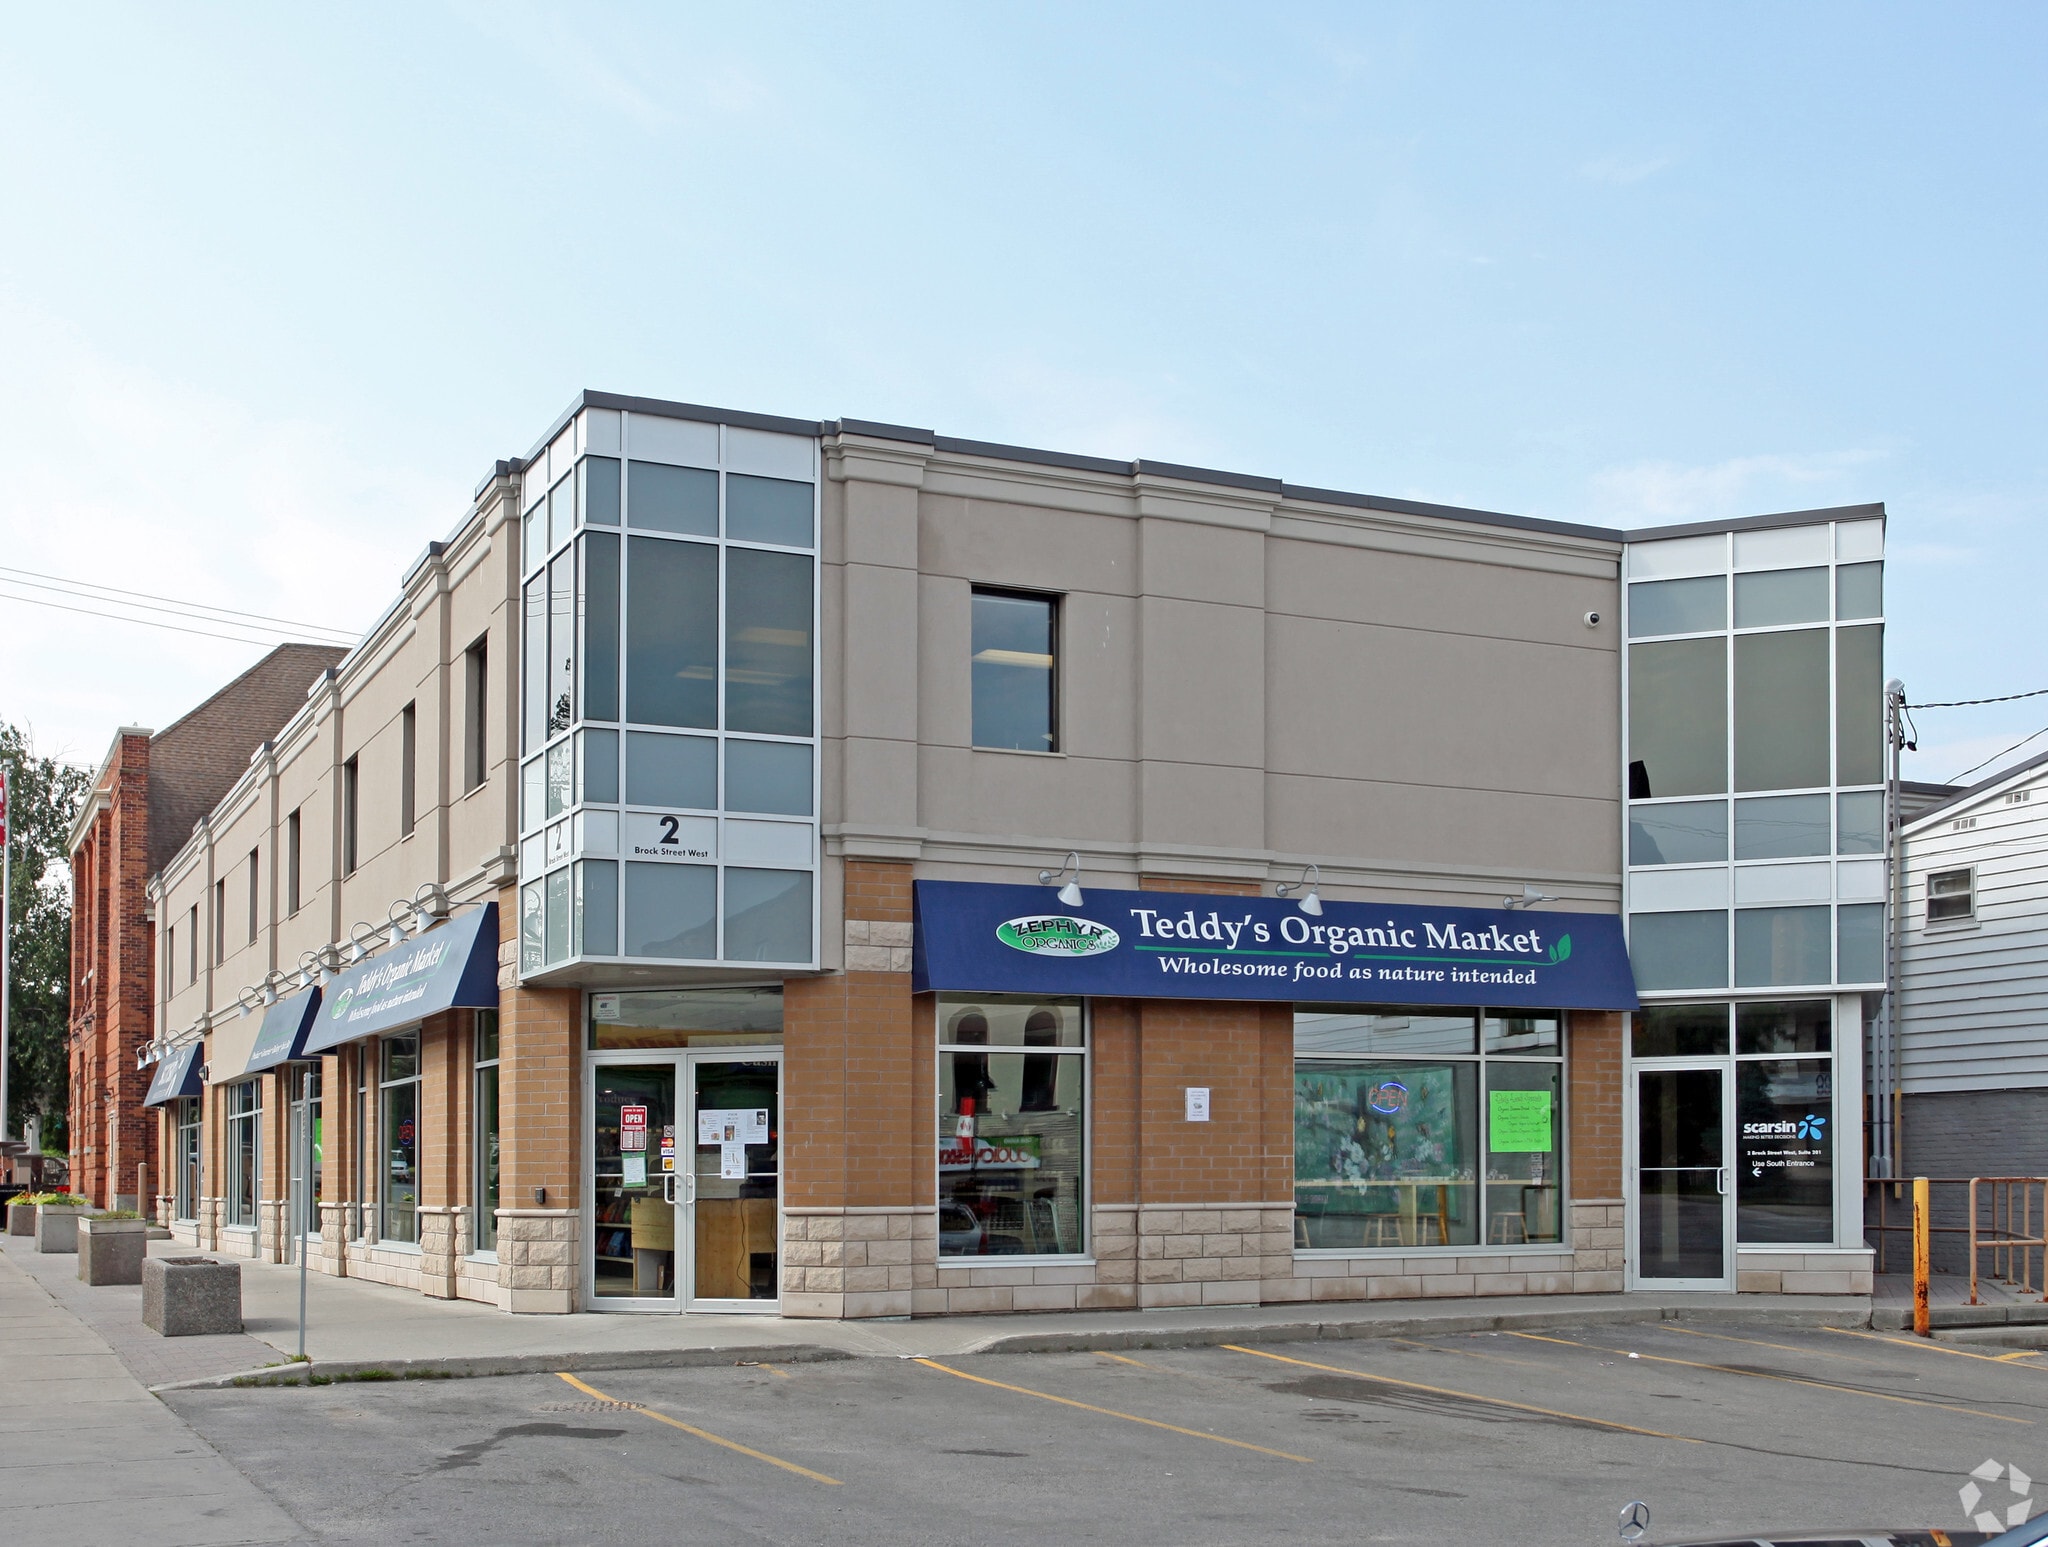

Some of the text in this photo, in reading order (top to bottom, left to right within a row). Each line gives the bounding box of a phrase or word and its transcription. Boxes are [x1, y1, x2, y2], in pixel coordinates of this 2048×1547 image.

[555, 822, 562, 851] 2
[659, 815, 680, 844] 2
[634, 846, 709, 858] Brock Street West
[1013, 918, 1103, 940] ZEPHYR
[1130, 908, 1543, 954] Teddy's Organic Market
[382, 954, 413, 991] Organic
[410, 940, 445, 975] Market
[1158, 956, 1537, 985] Wholesome food as nature intended
[1369, 1088, 1408, 1107] OPEN
[625, 1114, 643, 1124] OPEN
[1743, 1120, 1796, 1133] scarsin
